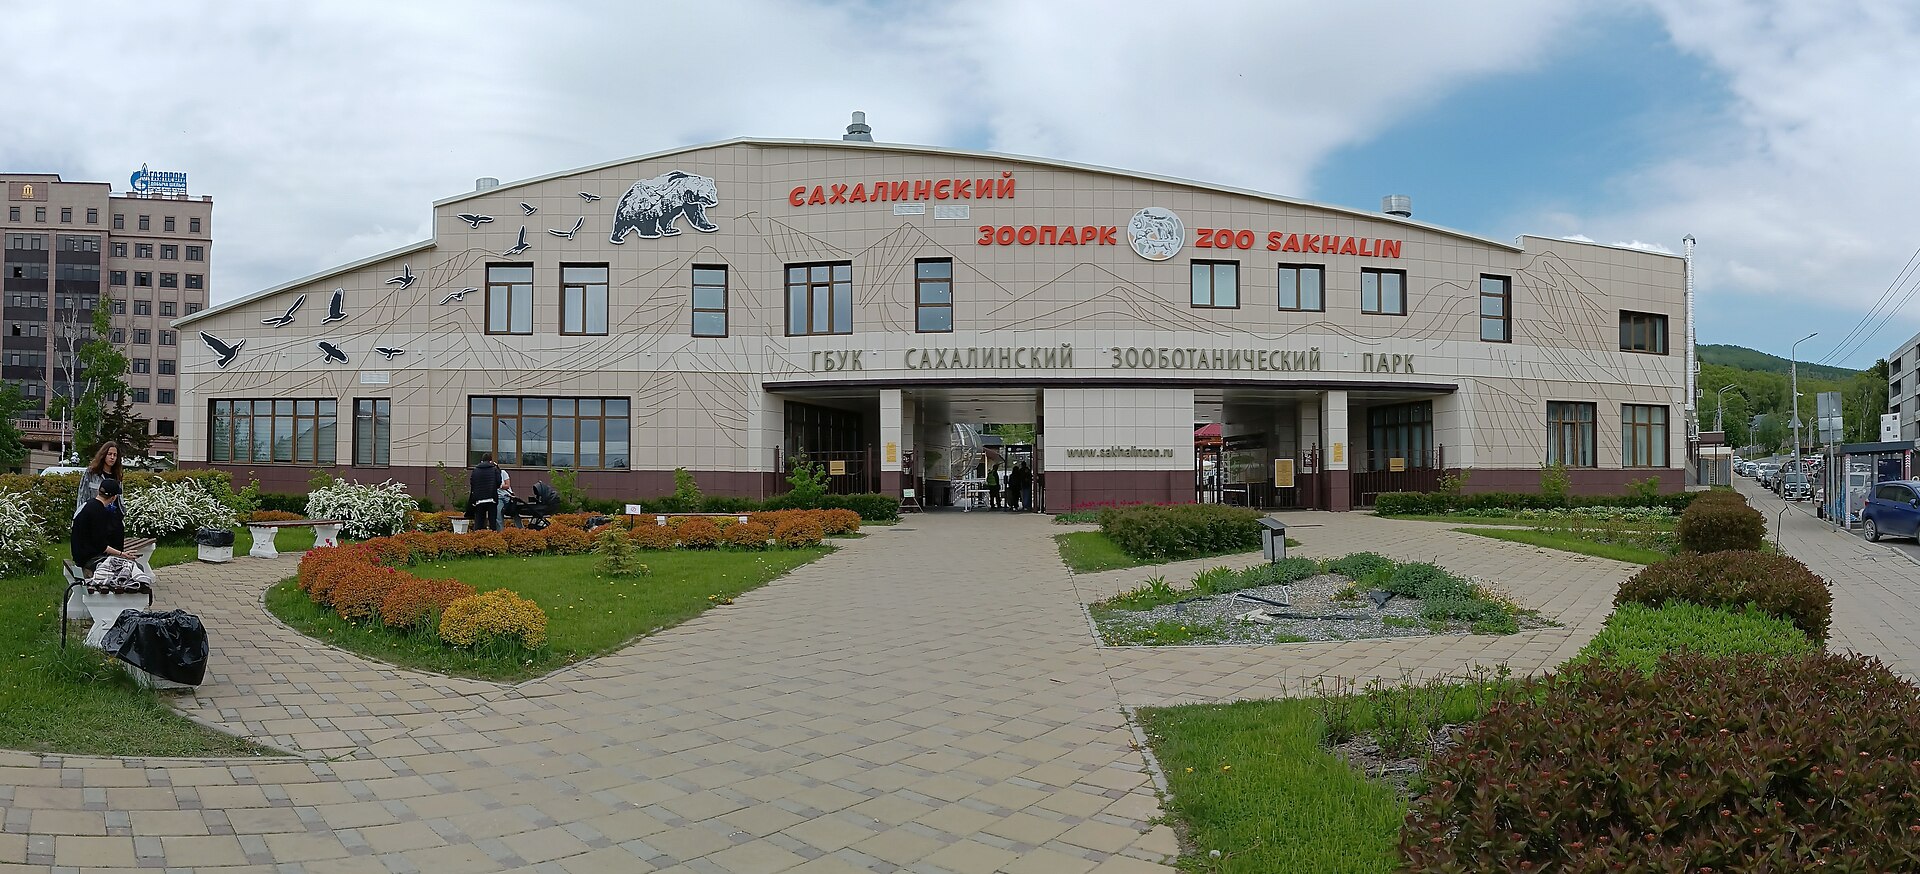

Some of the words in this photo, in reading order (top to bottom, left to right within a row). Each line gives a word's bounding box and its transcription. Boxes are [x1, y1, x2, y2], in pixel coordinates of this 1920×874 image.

[149, 171, 187, 182] ГАЗПРОМ
[789, 171, 1016, 206] САХАЛИНСКИЙ
[977, 225, 1118, 246] ЗООПАРК
[1196, 228, 1256, 250] ZOO
[1266, 231, 1403, 259] SAKHALIN
[811, 349, 863, 372] ГБУК
[904, 342, 1073, 370] САХАЛИНСКИЙ
[1111, 346, 1321, 372] ЗООБОТАНИЧЕСКИЙ
[1362, 351, 1415, 374] ПАРК
[1066, 445, 1174, 458] www.sakhalinzoo.ru
